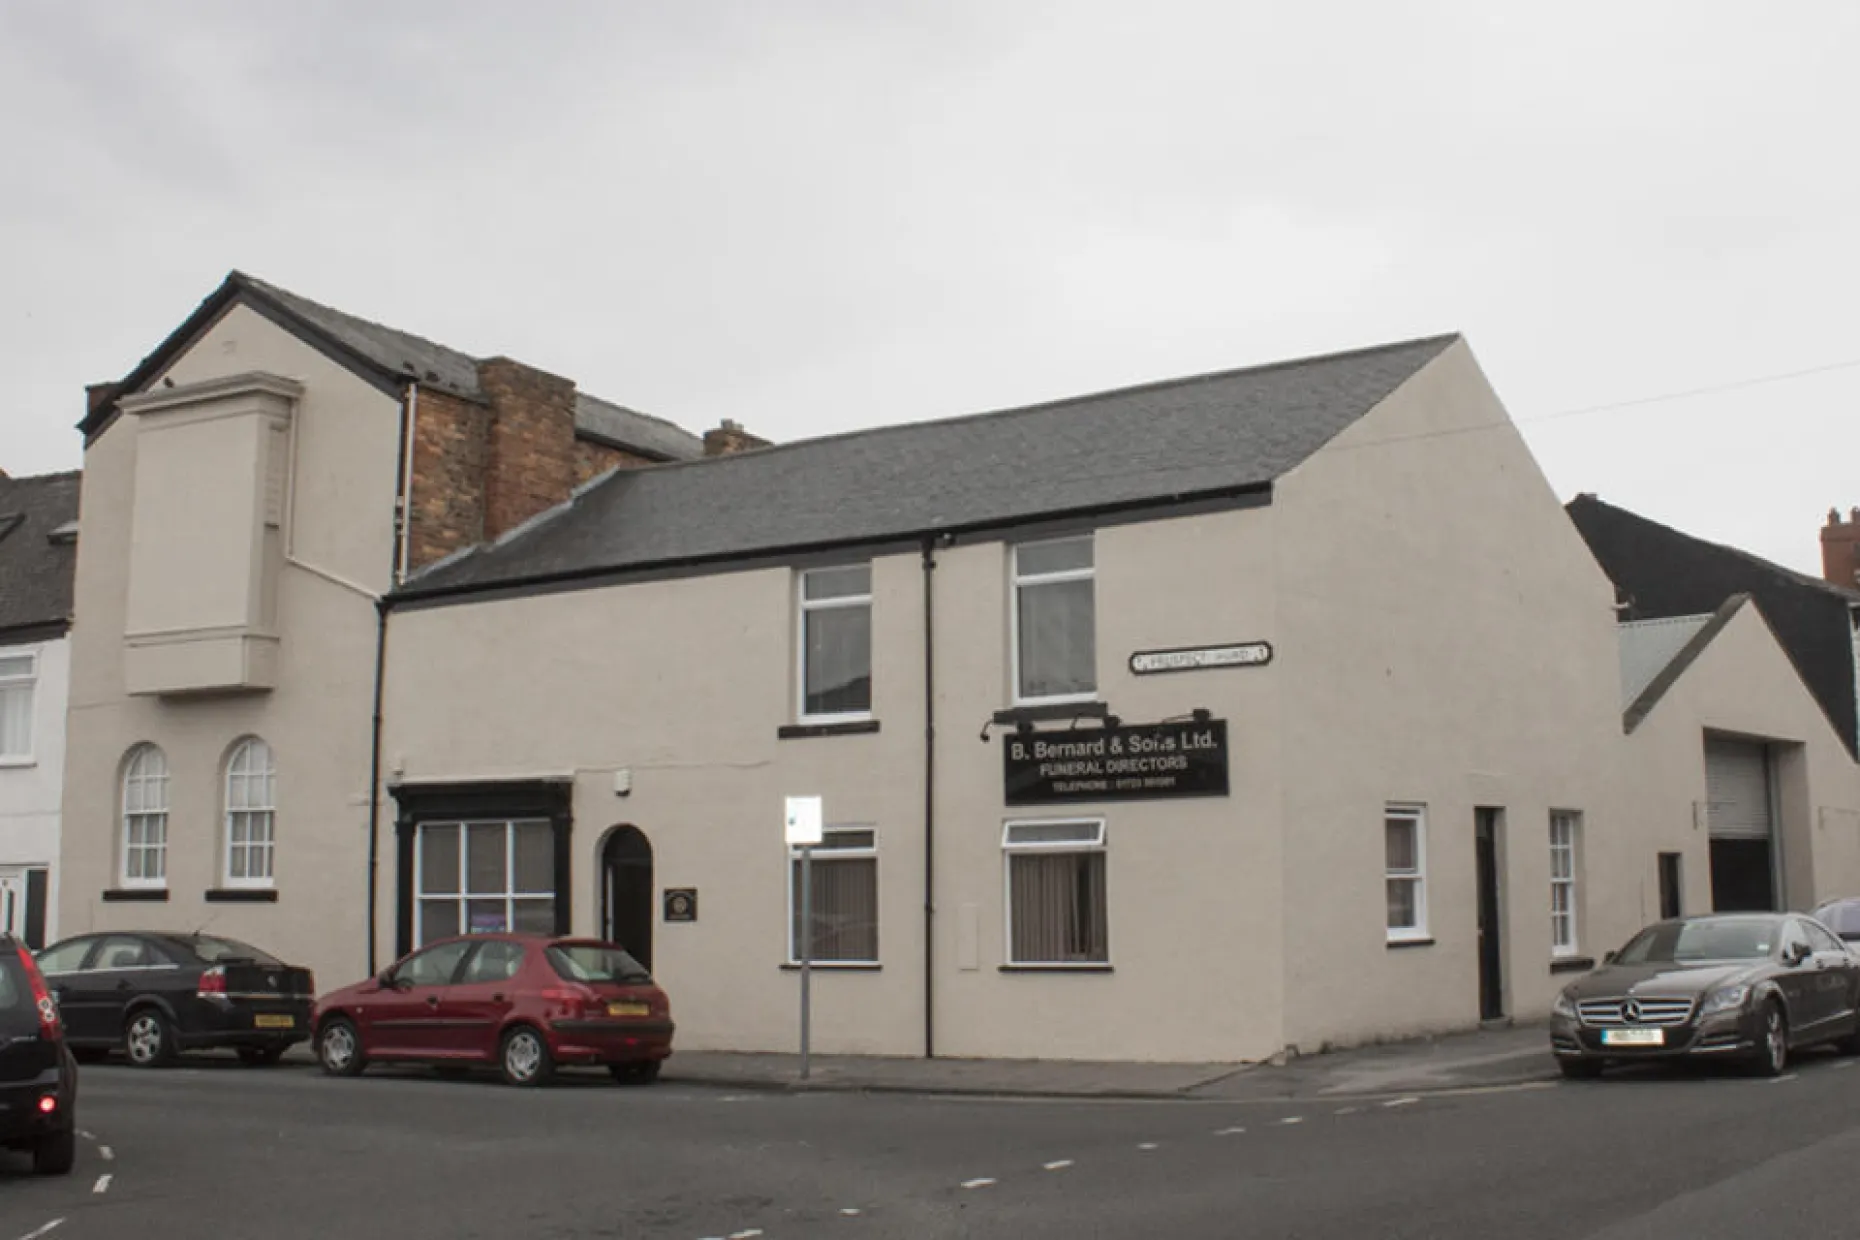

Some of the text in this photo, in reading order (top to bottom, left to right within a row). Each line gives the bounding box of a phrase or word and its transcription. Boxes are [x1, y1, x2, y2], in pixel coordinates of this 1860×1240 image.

[1011, 742, 1031, 760] B.
[1034, 738, 1105, 759] Bernard
[1109, 735, 1123, 754] &
[1181, 729, 1218, 749] Ltd.
[1040, 754, 1189, 777] FUNERAL DIRECTORS
